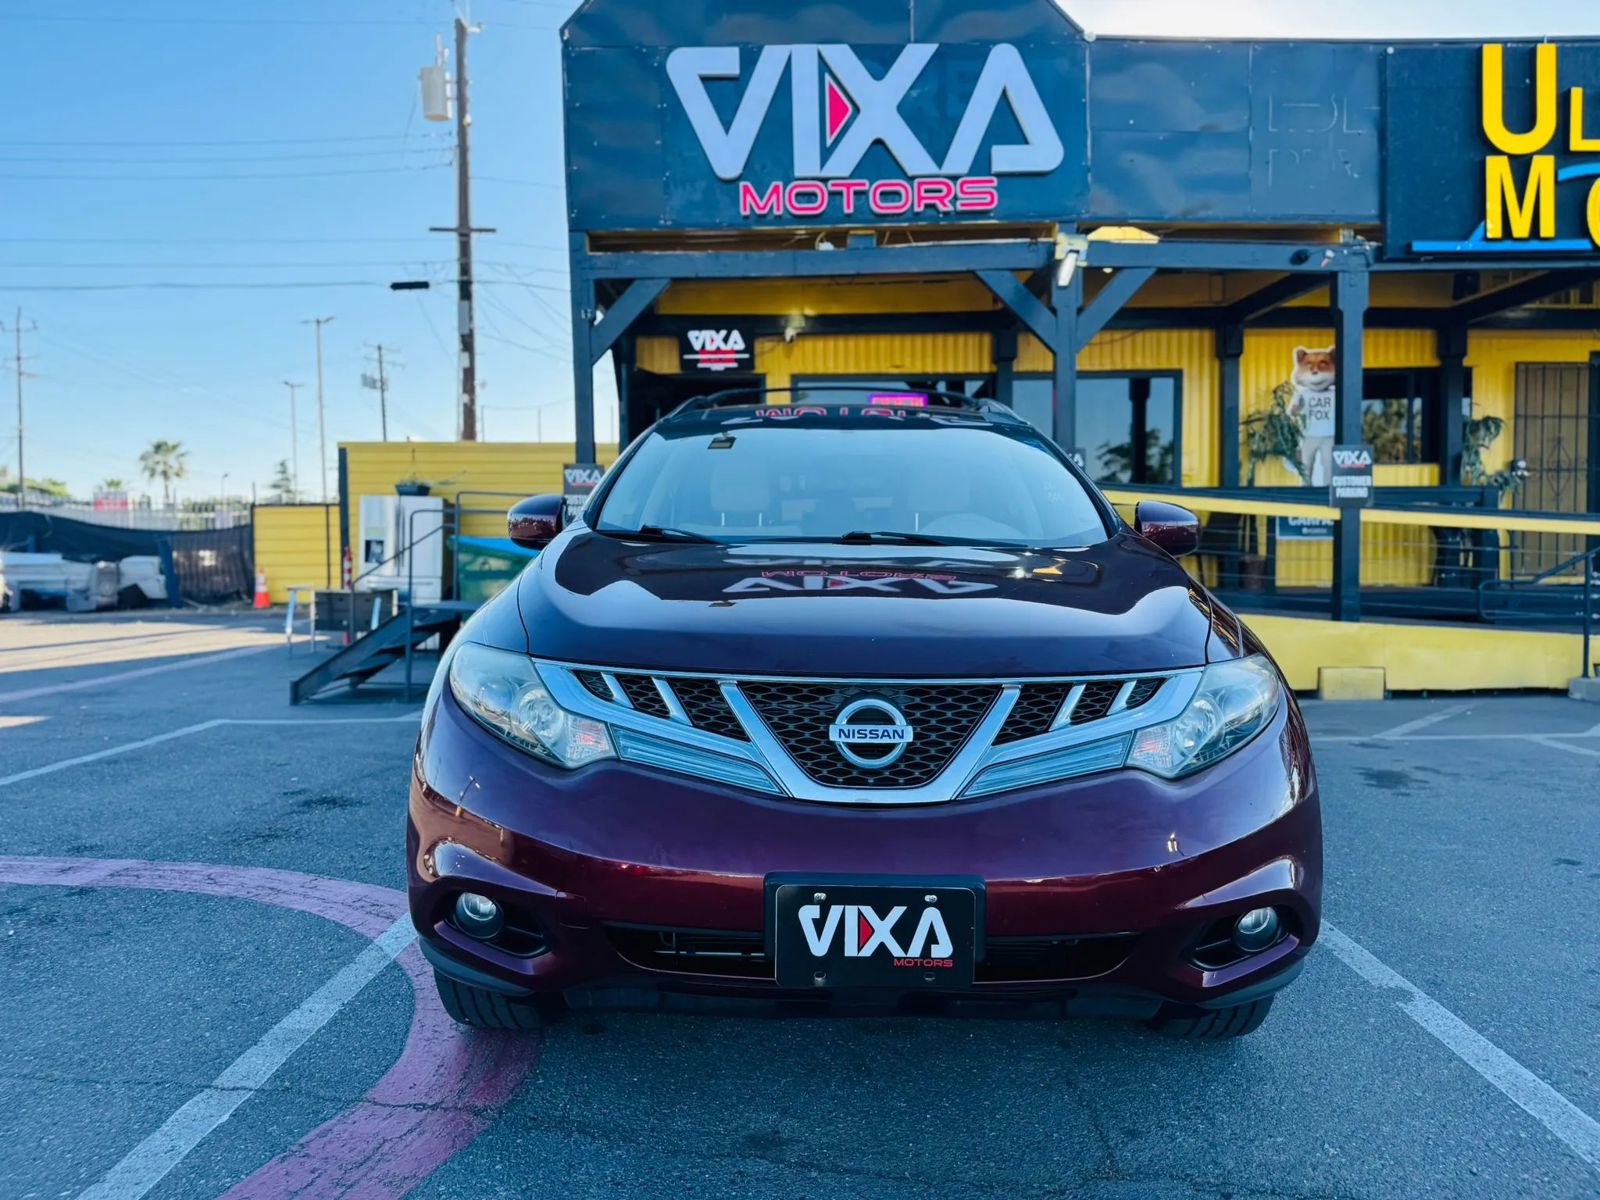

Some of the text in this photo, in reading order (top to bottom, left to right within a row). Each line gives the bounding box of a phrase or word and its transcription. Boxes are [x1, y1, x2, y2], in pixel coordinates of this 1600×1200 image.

[666, 43, 1065, 179] VIXA
[739, 177, 998, 216] MOTORS
[687, 329, 746, 351] VIXA
[1308, 398, 1332, 408] CAR
[1309, 409, 1331, 420] FOX
[1333, 450, 1372, 465] VIXA
[838, 727, 905, 740] NISSAN
[798, 904, 953, 958] VIXA
[893, 958, 953, 967] MOTORS
